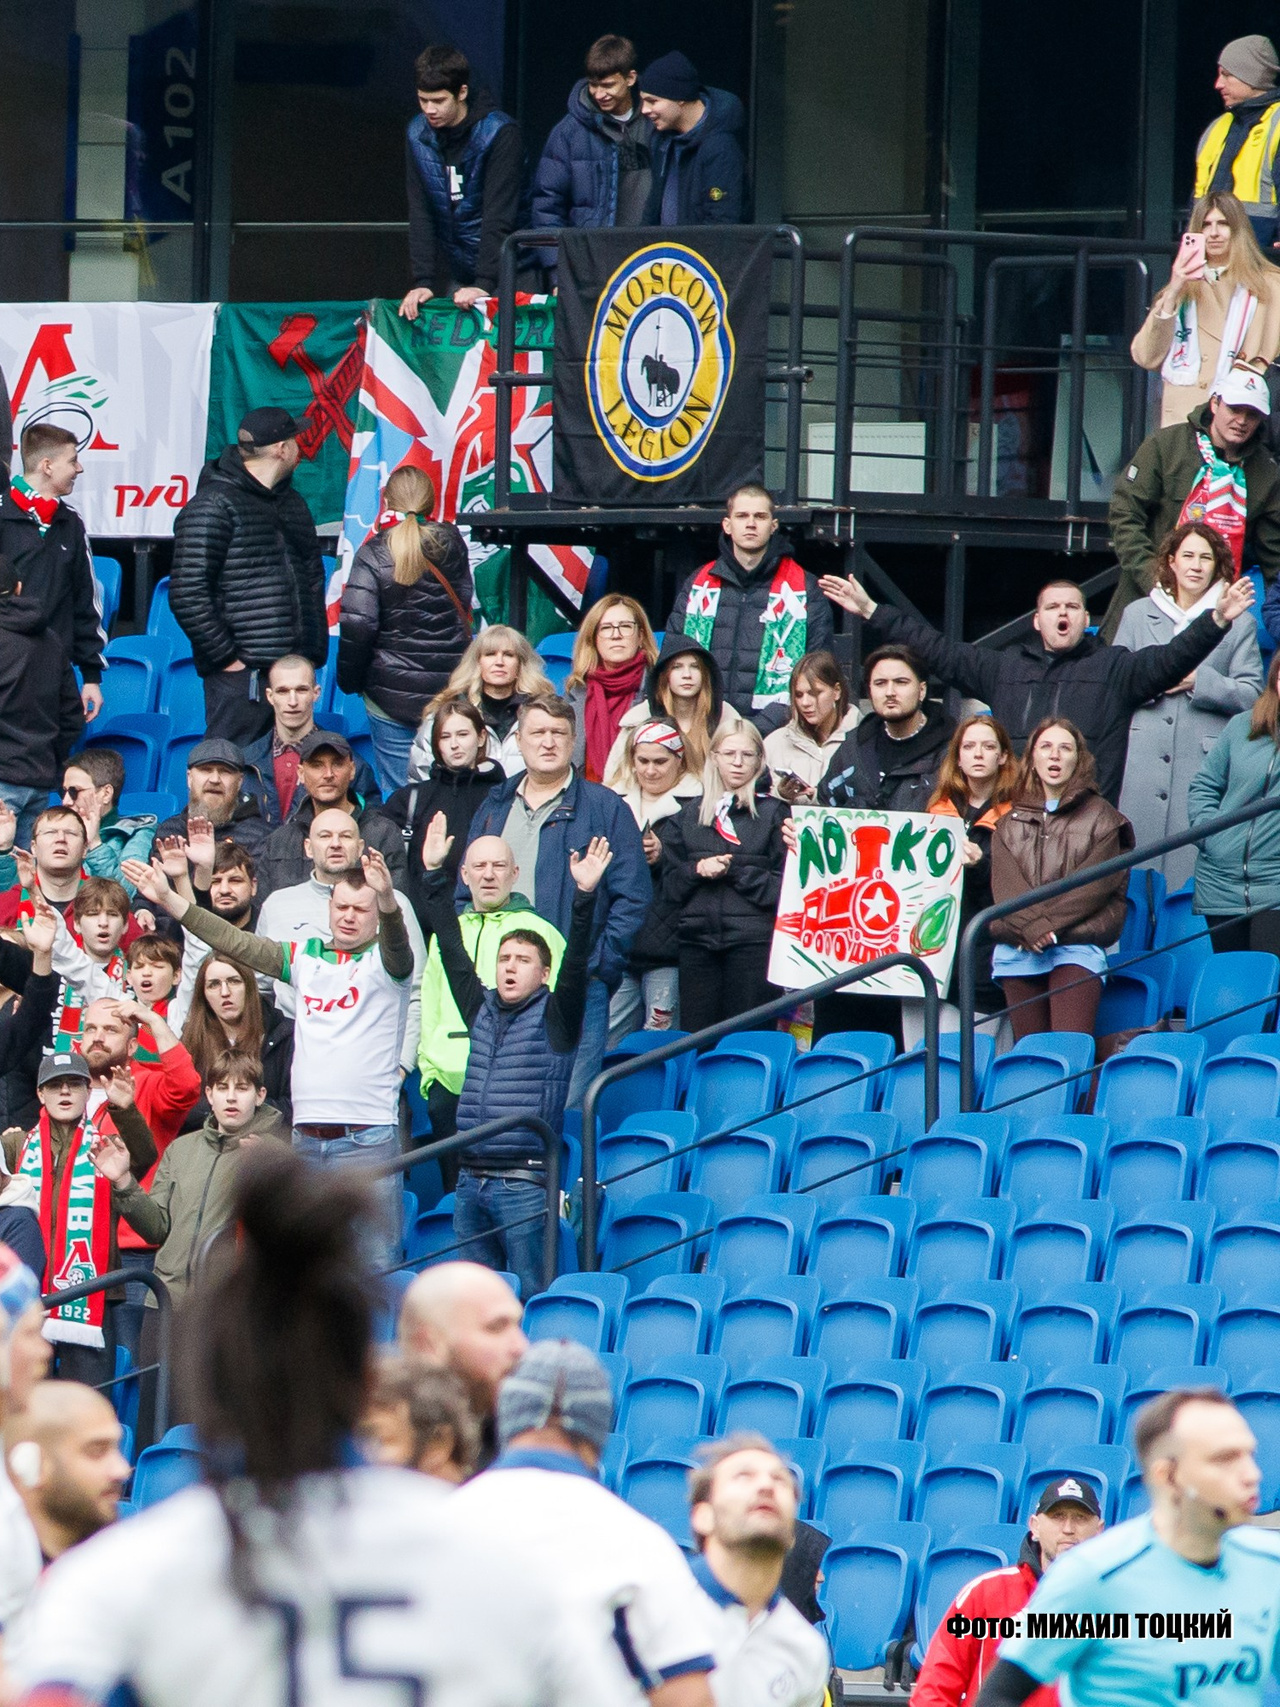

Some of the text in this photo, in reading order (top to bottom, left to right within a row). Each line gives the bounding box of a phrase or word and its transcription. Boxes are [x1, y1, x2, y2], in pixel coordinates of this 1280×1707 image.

[161, 47, 197, 204] A102
[604, 262, 720, 340] MOSCOW
[604, 391, 712, 464] LEGION
[57, 1305, 91, 1321] 1922
